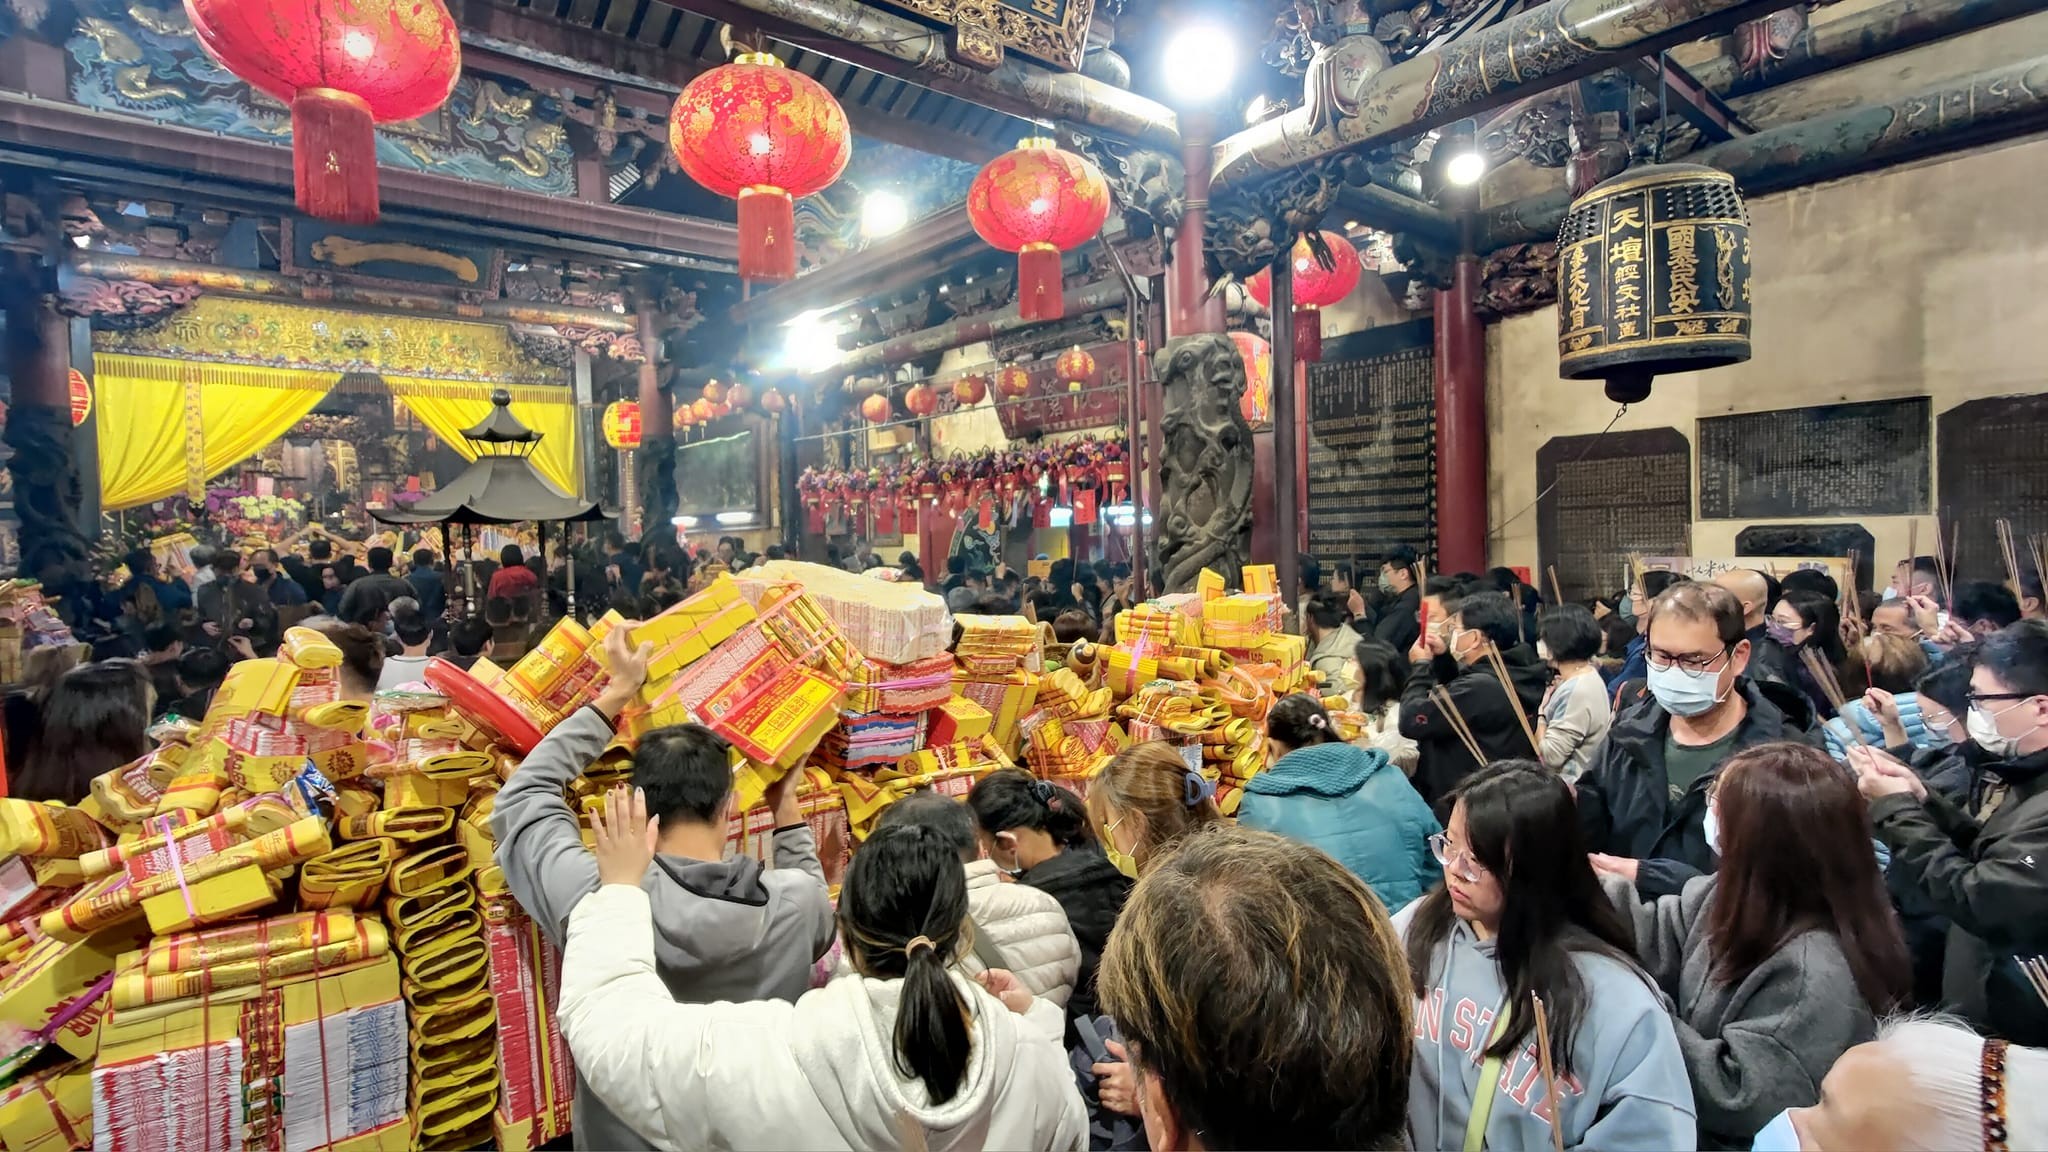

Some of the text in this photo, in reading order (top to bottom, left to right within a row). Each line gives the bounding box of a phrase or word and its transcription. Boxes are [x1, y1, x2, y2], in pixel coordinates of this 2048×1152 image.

[311, 236, 478, 283] 一
[1666, 225, 1700, 314] 國泰民安
